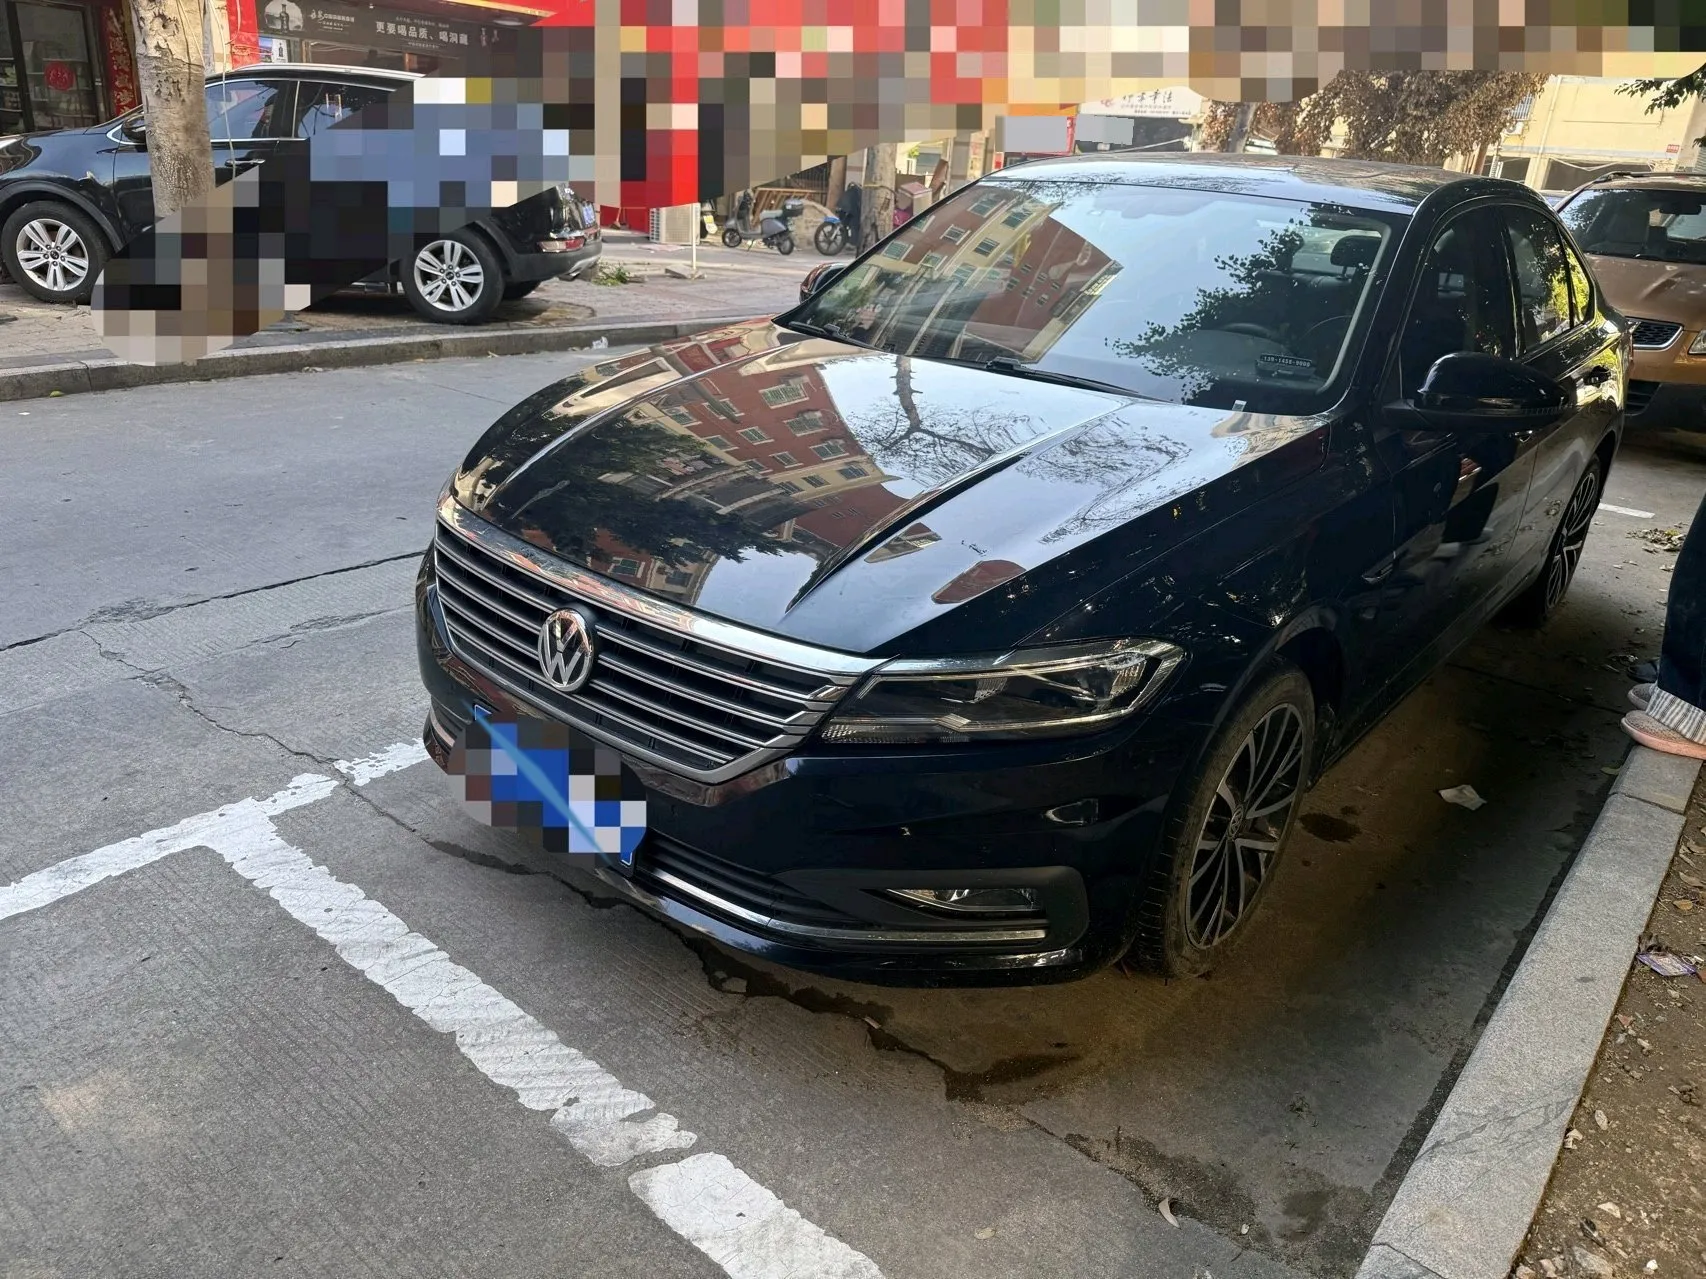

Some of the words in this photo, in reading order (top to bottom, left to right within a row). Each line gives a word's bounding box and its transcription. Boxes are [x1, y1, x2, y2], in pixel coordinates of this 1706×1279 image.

[375, 21, 469, 46] 更要喝品质、喝洞藏
